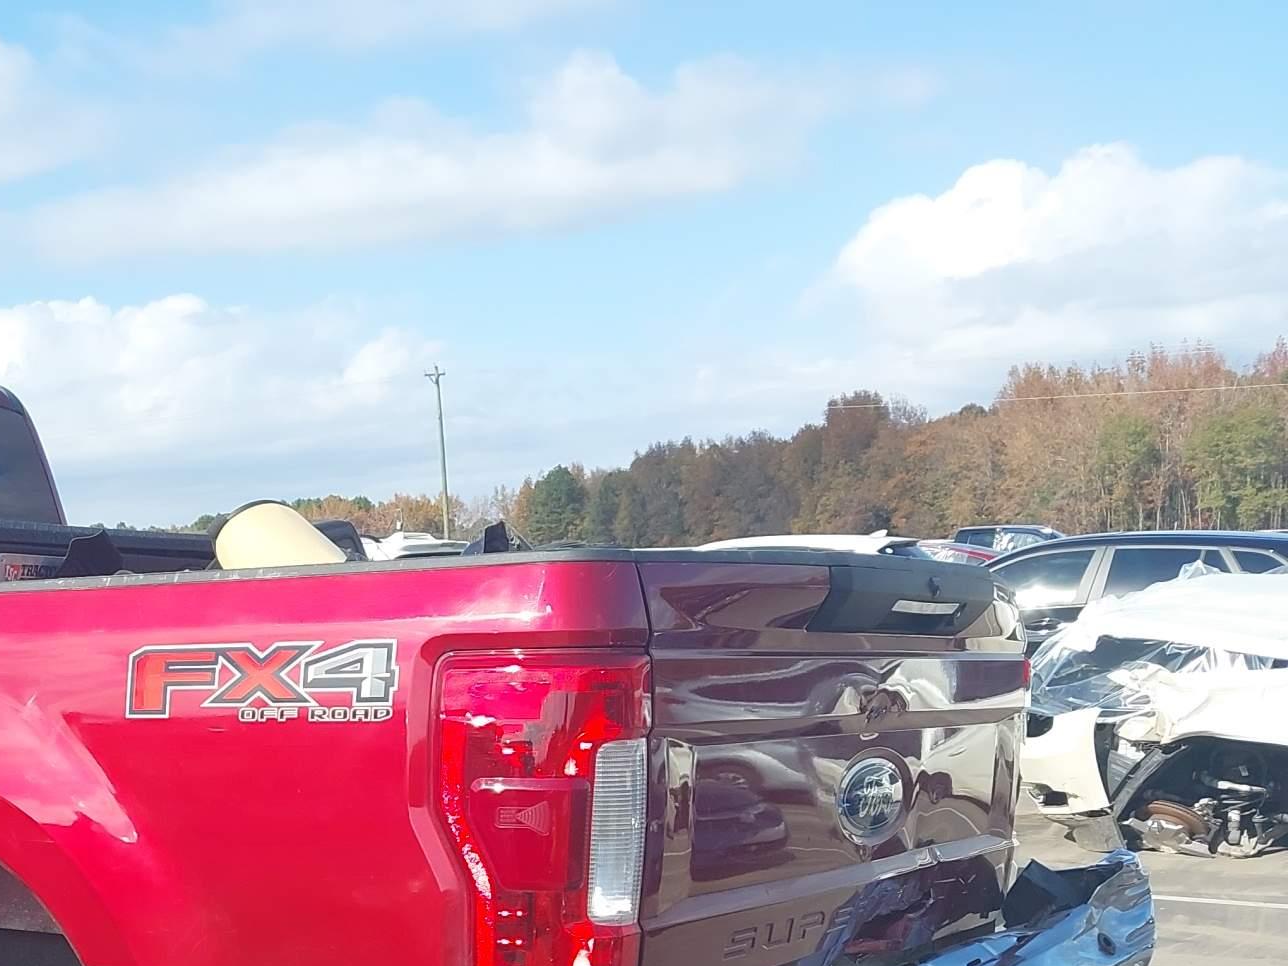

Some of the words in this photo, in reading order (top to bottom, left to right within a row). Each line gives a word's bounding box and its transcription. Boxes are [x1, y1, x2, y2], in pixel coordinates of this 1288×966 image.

[125, 639, 399, 718] FX4
[238, 707, 300, 722] OFF
[307, 706, 394, 722] ROAD
